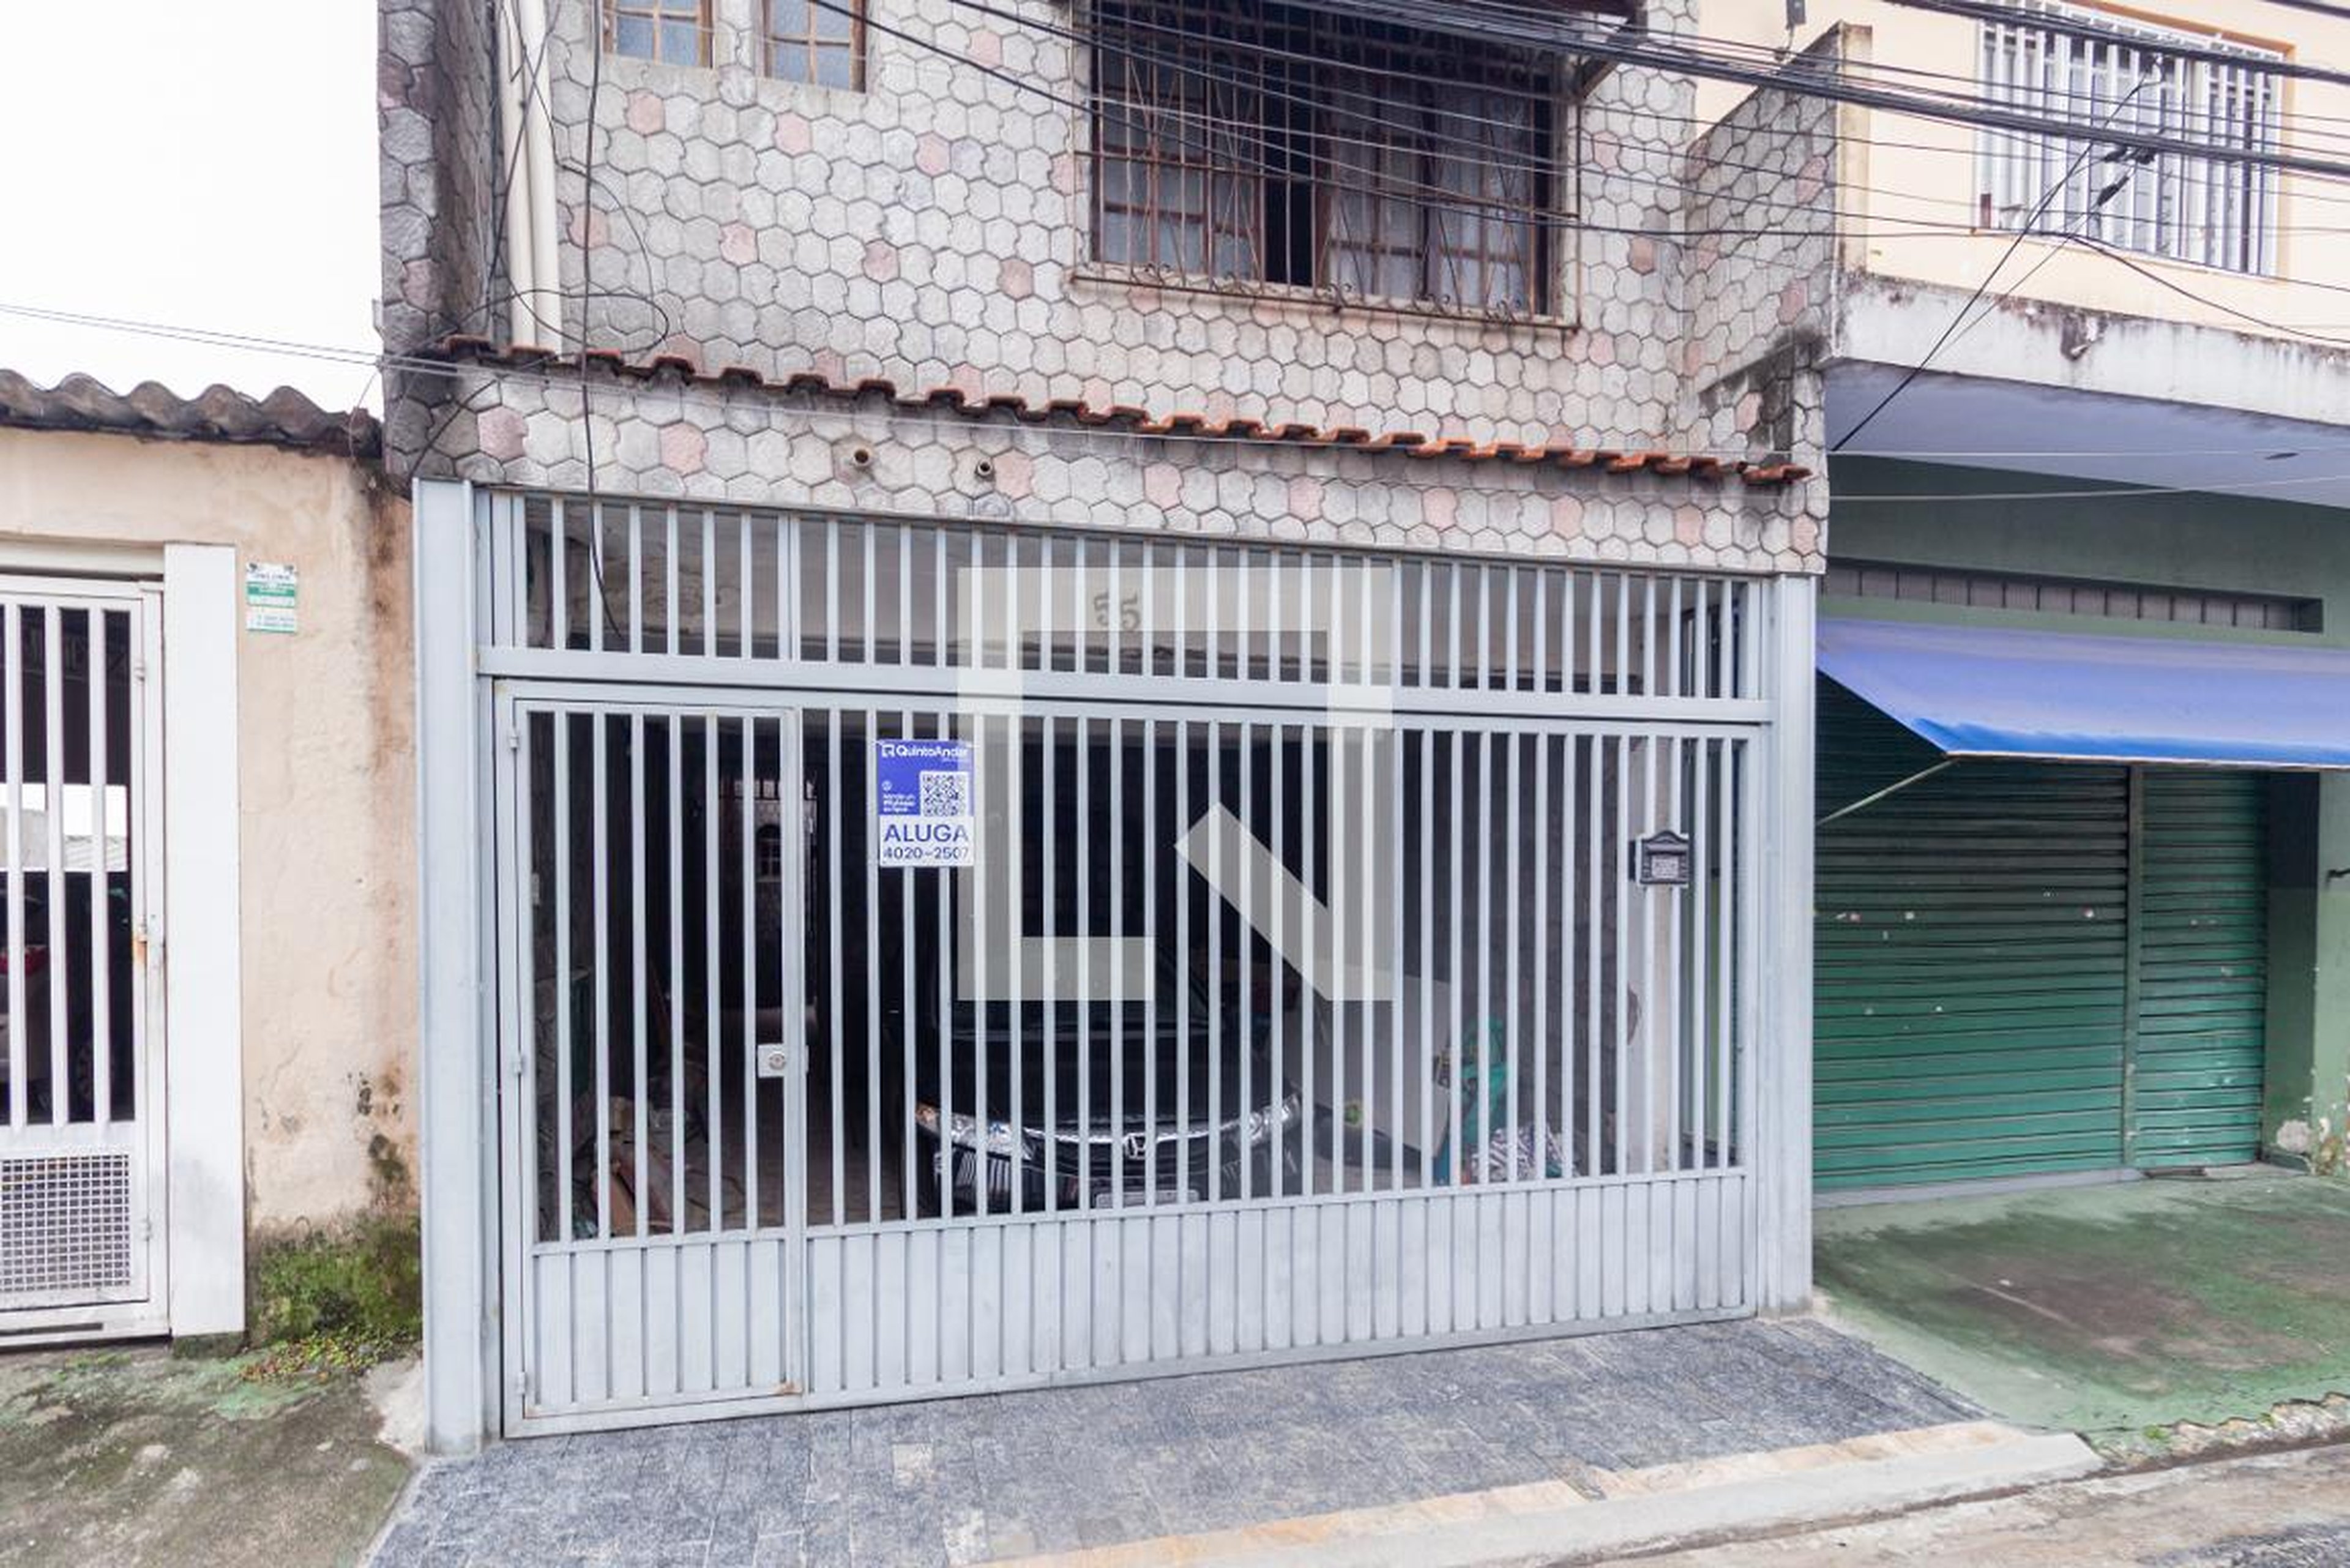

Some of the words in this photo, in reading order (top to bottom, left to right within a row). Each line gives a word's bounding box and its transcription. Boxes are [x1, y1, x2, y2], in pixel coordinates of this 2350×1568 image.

[1094, 589, 1141, 632] 55
[884, 824, 969, 842] ALUGA
[883, 847, 969, 859] 4020-2507
